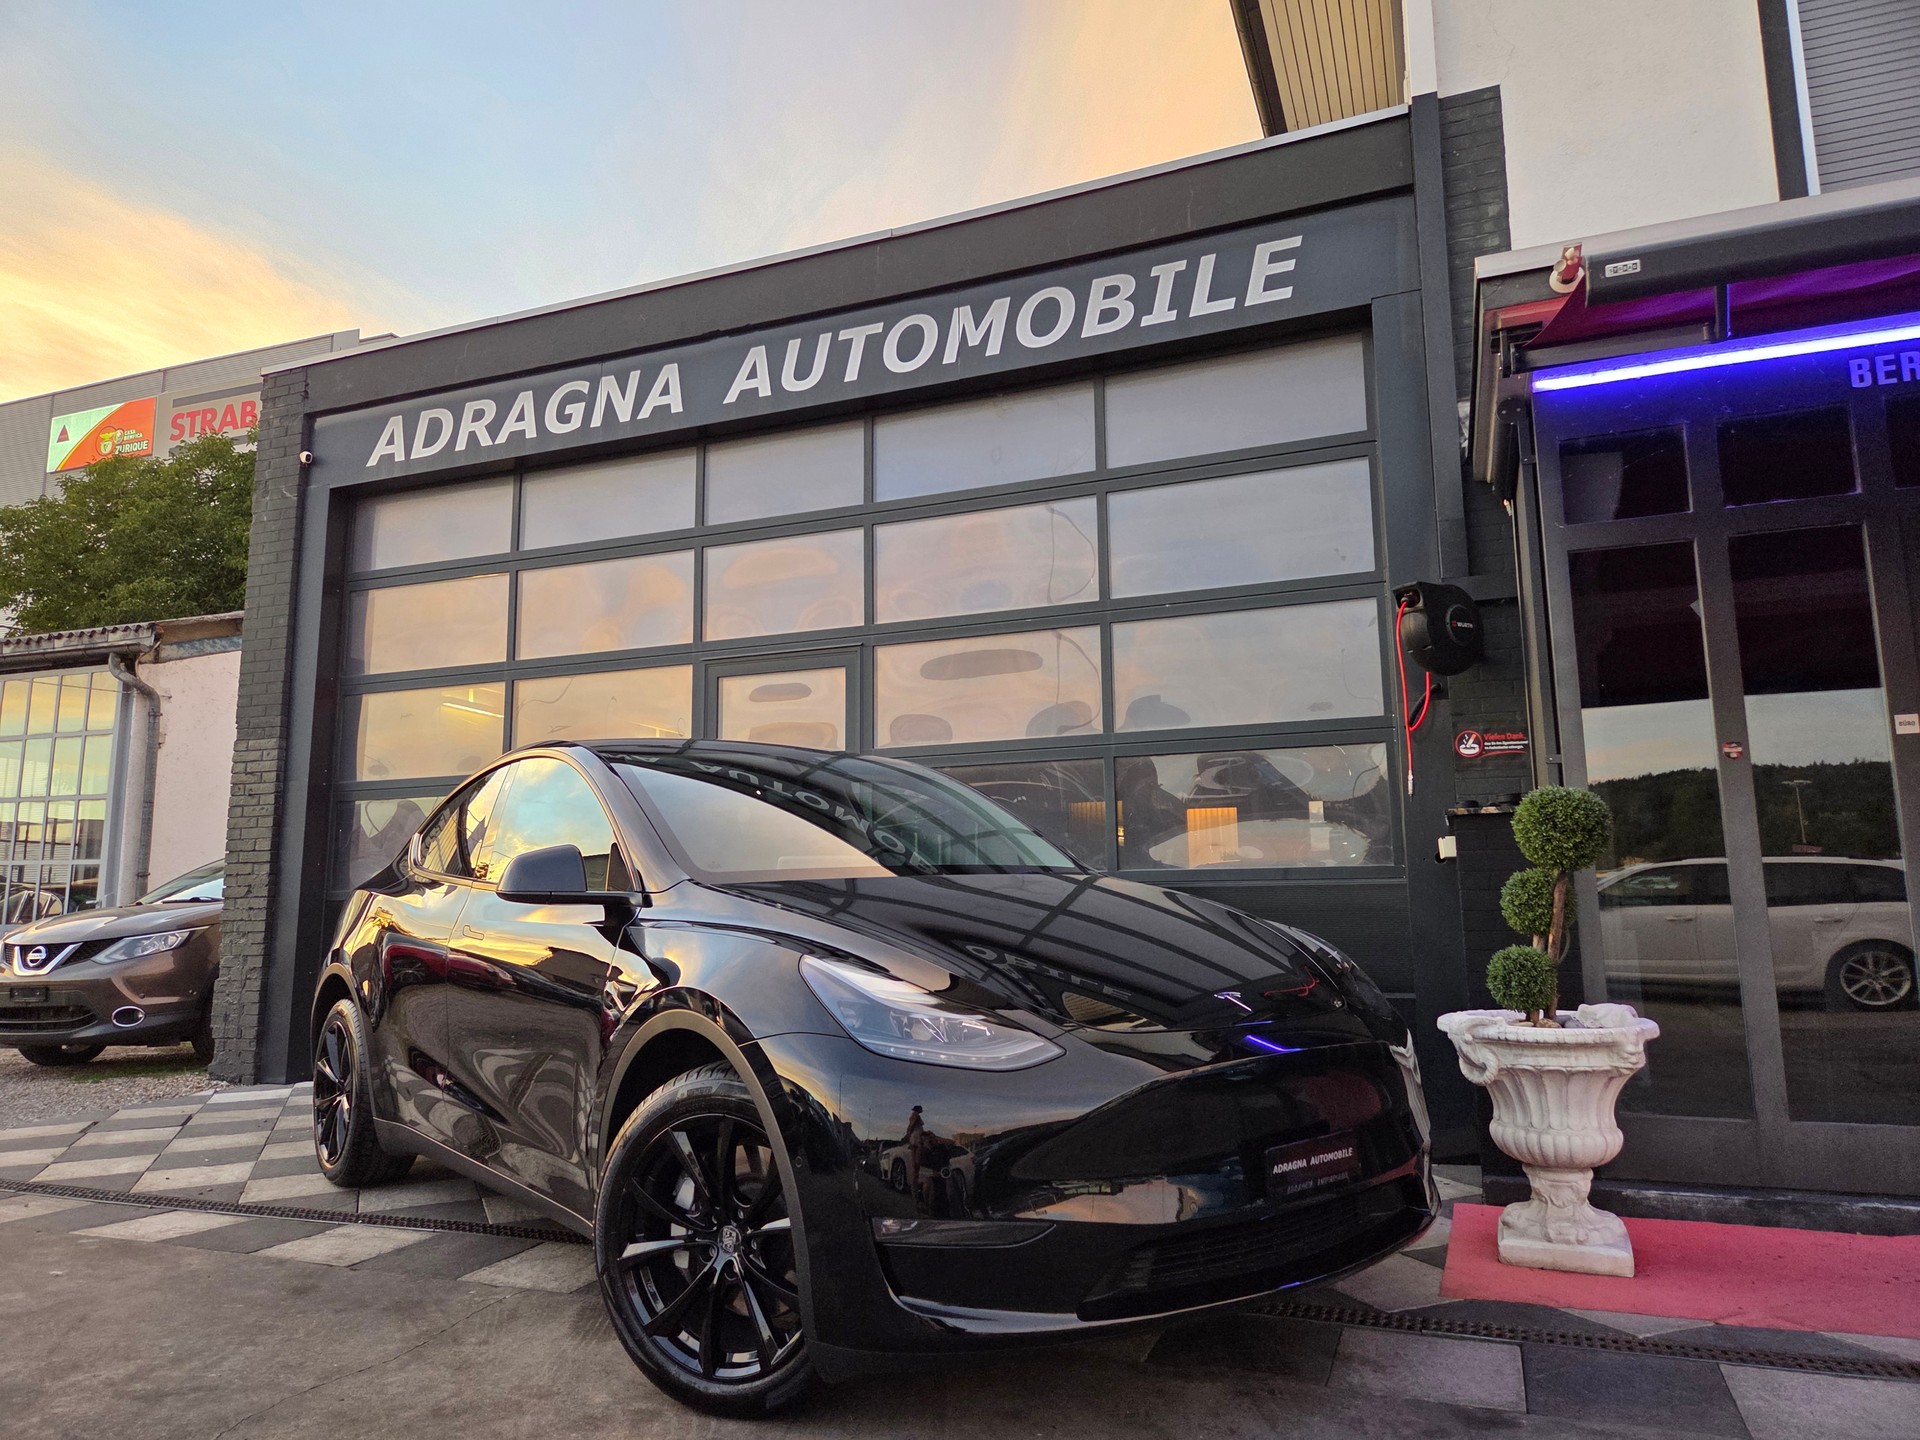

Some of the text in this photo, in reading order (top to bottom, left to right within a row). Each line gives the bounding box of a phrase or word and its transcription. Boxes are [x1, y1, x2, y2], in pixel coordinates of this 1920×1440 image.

[366, 235, 1303, 468] ADRAGNA AUTOMOBILE
[1848, 351, 1920, 388] BER
[114, 440, 149, 455] ZURIQUE
[1273, 1147, 1353, 1175] ADRAGNA AUTOMOBILE
